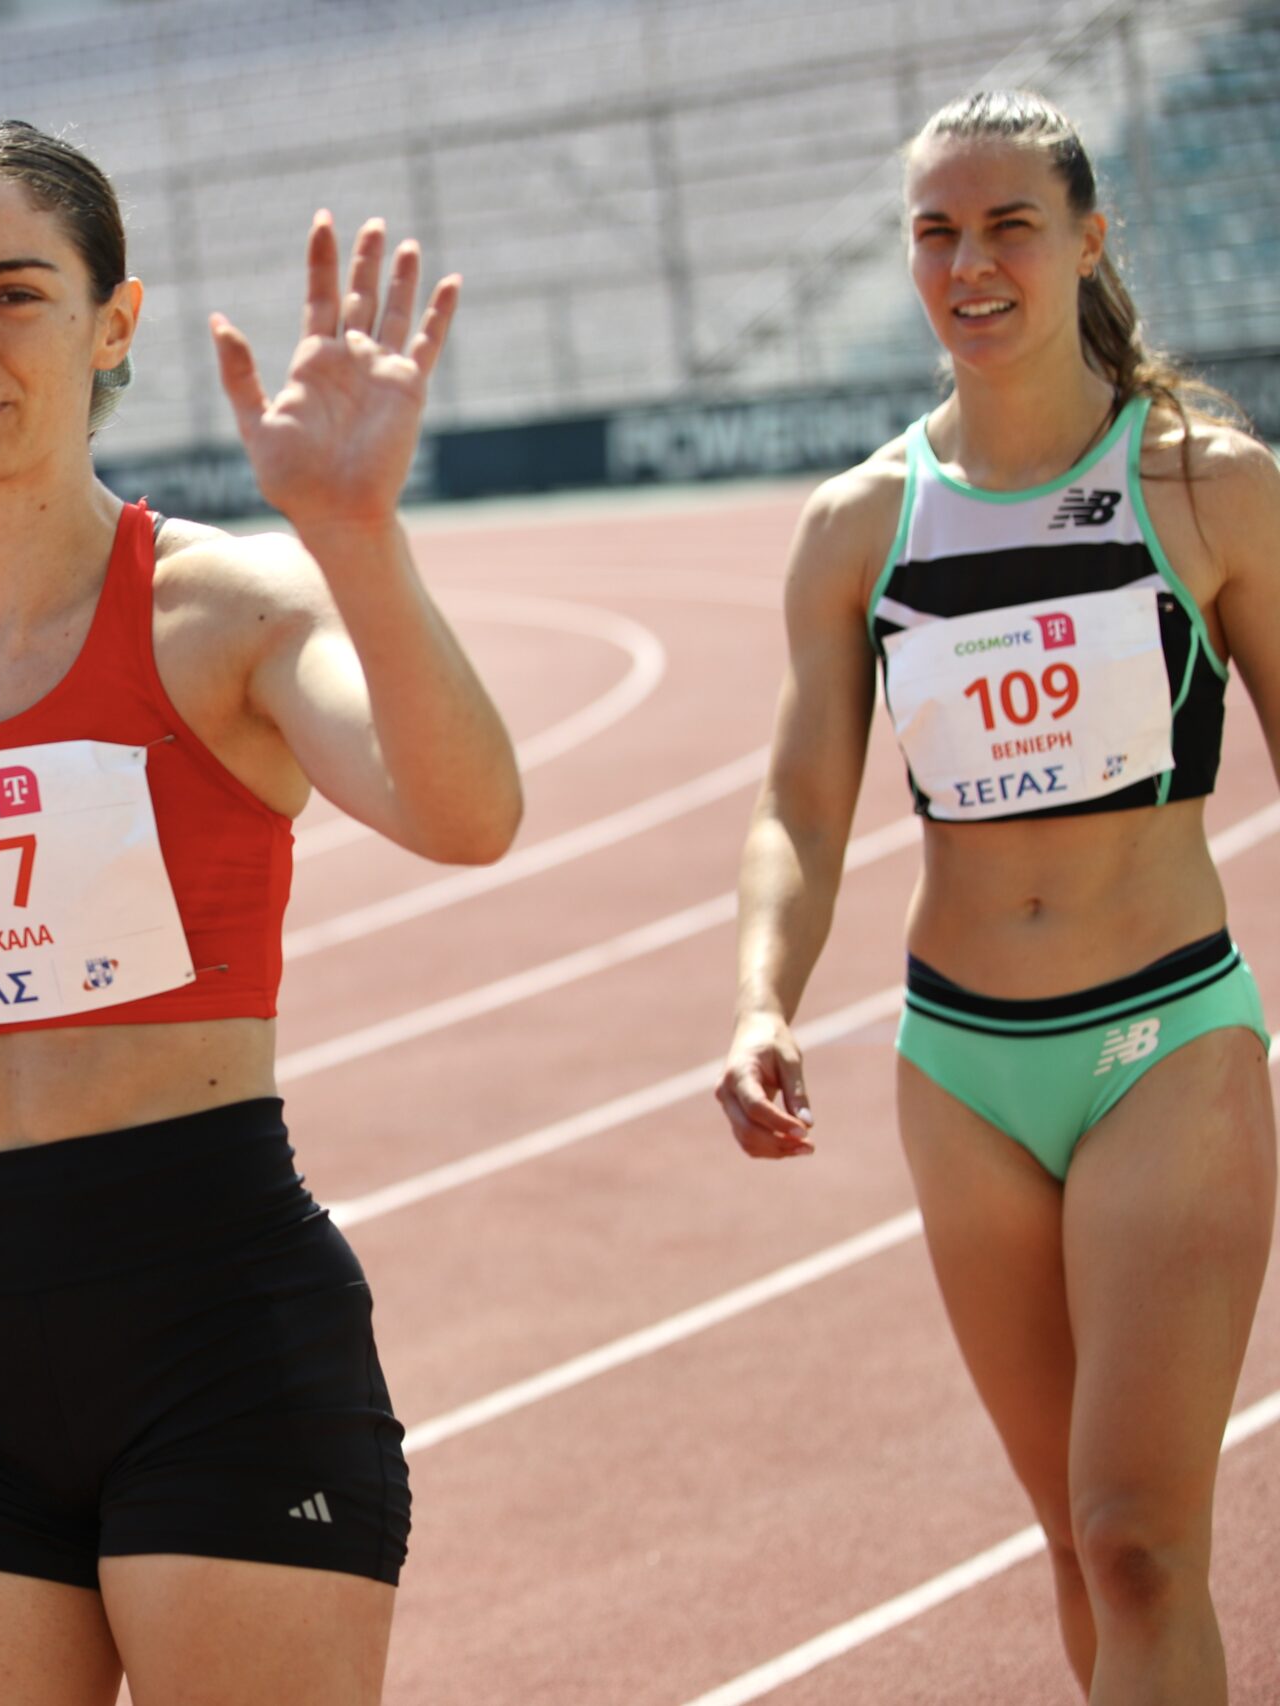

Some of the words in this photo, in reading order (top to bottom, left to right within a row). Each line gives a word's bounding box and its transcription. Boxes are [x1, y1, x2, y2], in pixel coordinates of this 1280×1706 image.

[954, 629, 1033, 657] COSMOTE
[963, 661, 1080, 732] 109
[991, 731, 1073, 761] ΒΕΝΙΕΡΗ
[953, 764, 1068, 808] ΣΕΓΑΣ
